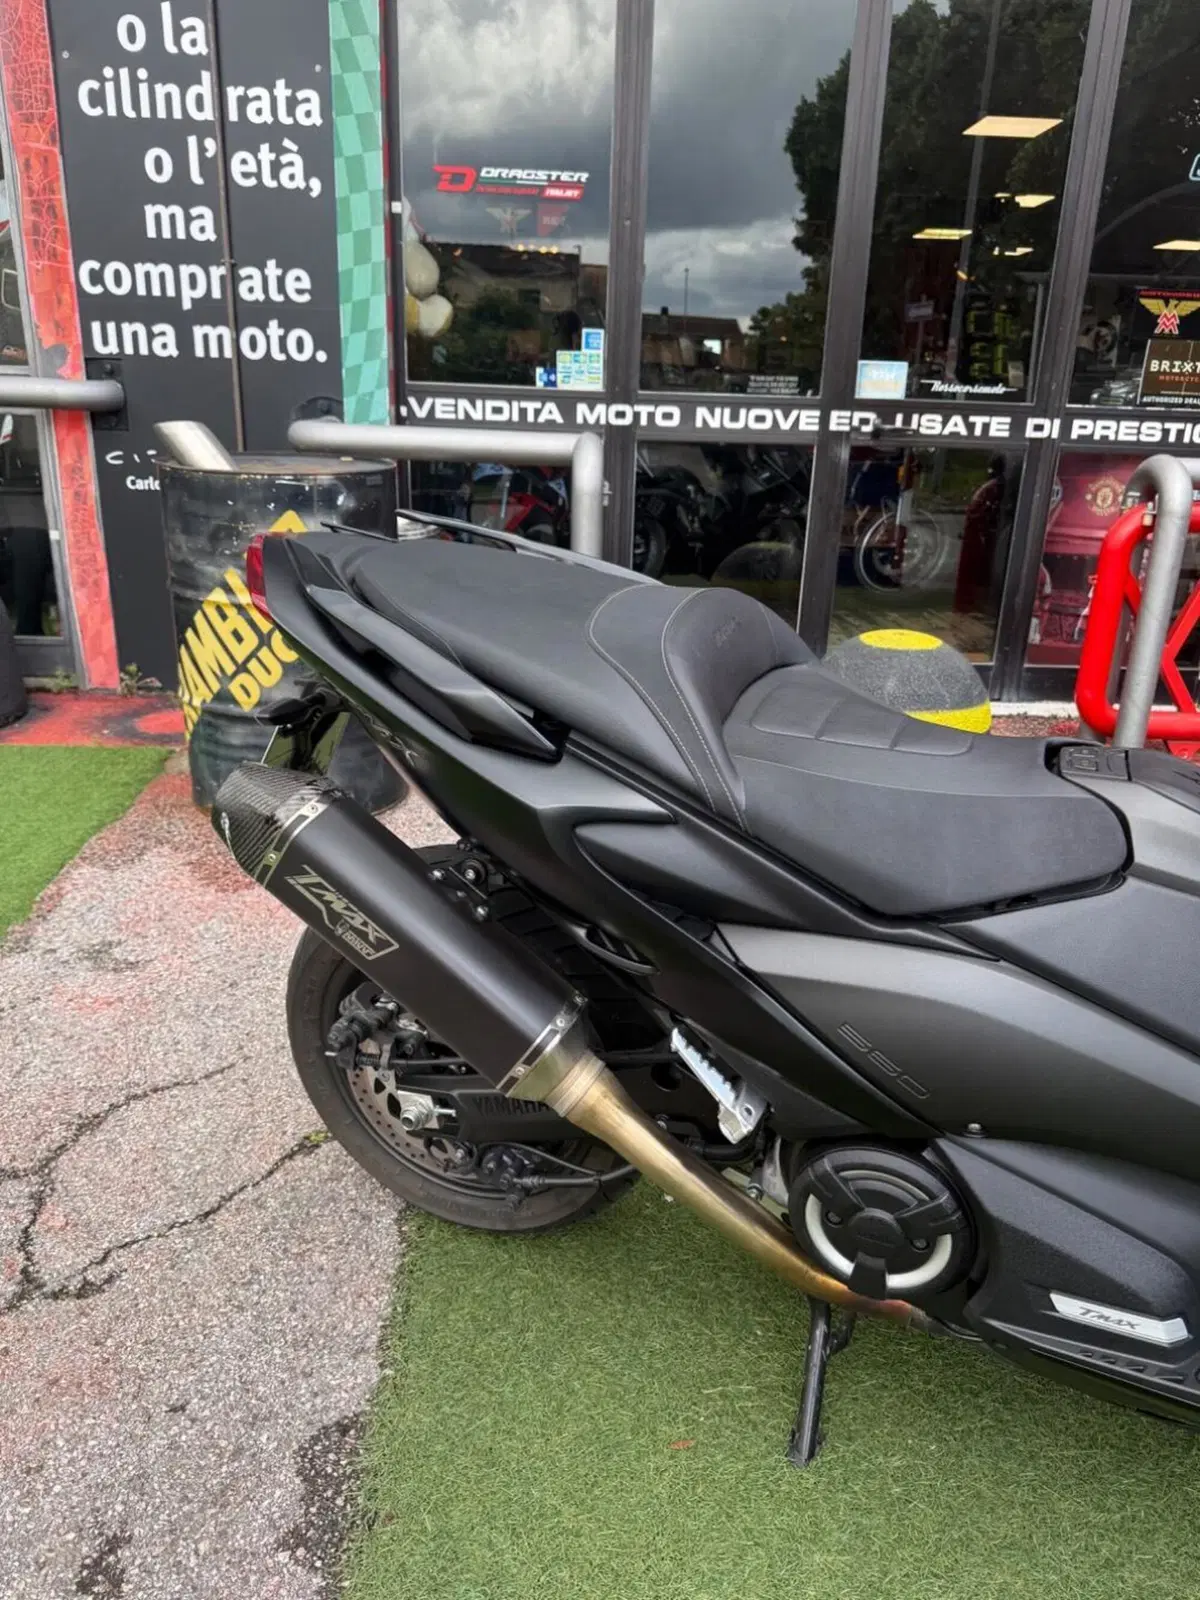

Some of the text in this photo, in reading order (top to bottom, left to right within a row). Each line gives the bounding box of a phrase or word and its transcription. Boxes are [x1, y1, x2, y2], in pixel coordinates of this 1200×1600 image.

[117, 1, 209, 56] o la
[78, 66, 323, 126] cilindrata
[144, 147, 173, 183] o
[480, 166, 590, 183] DRAGSTER
[144, 204, 217, 241] ma
[79, 259, 311, 310] comprate
[91, 319, 328, 363] una moto.
[407, 396, 564, 424] VENDITA
[576, 402, 681, 427] MOTO
[695, 406, 821, 431] NUOVE
[895, 412, 1012, 438] USATE
[1025, 417, 1061, 439] DI
[1078, 1306, 1141, 1330] TMAX
